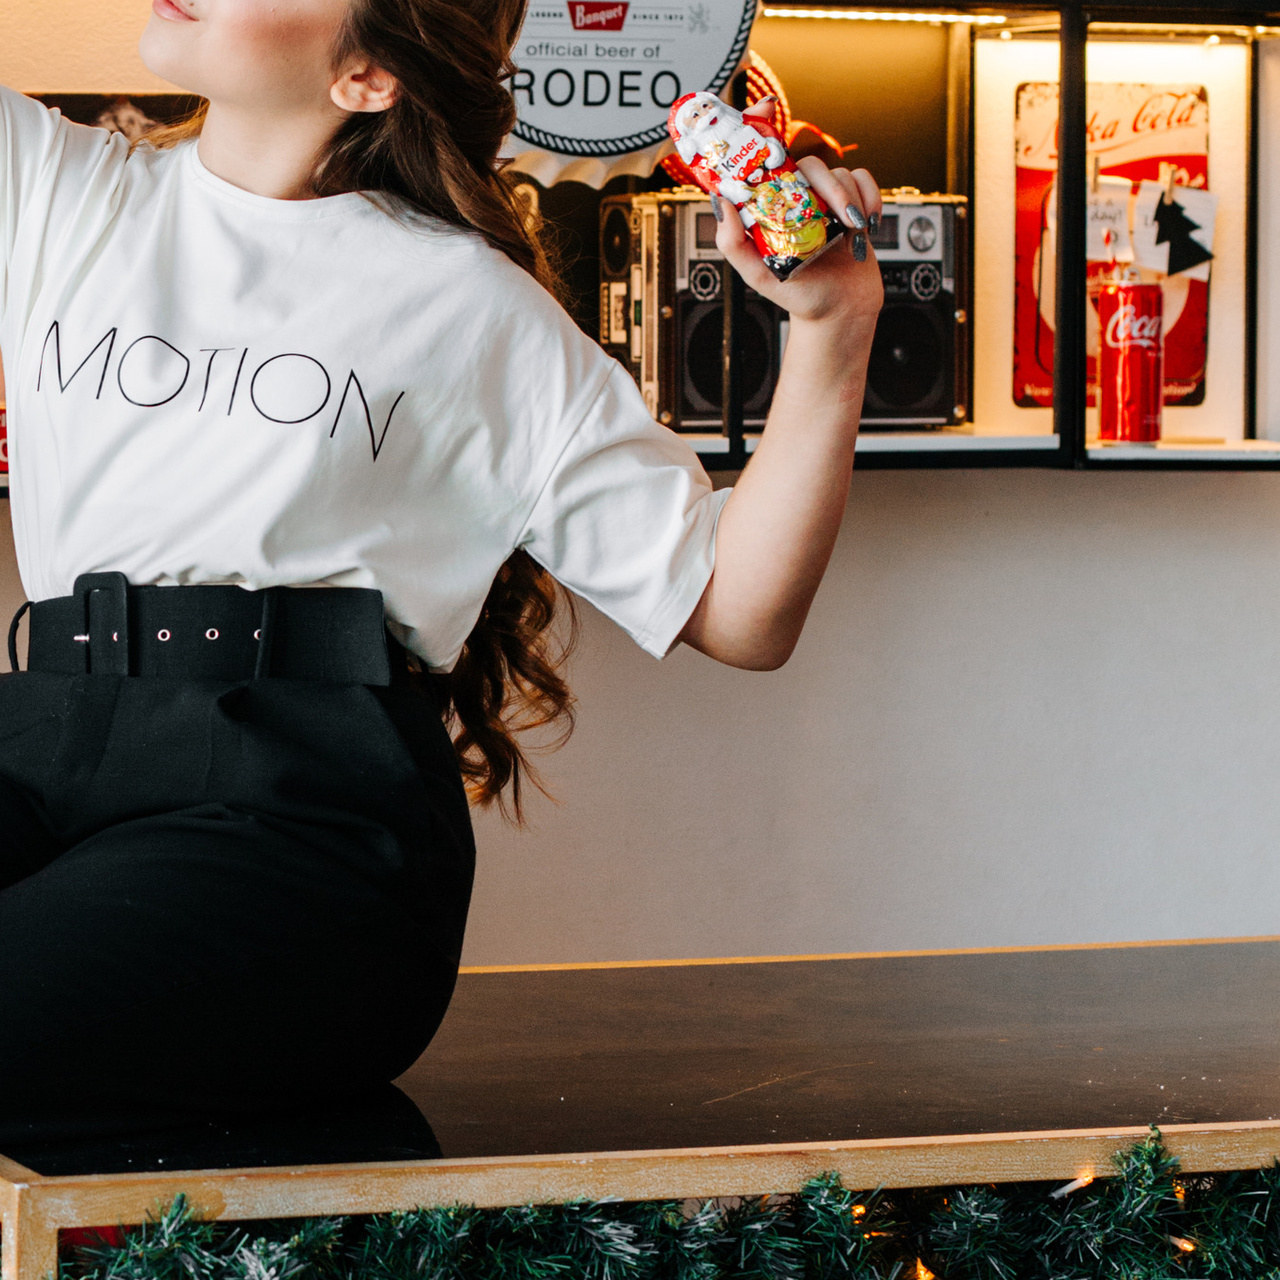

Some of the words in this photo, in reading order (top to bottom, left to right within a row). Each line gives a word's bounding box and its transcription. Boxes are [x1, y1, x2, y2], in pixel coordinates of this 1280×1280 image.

[526, 42, 588, 57] official
[595, 43, 637, 58] beer
[643, 44, 661, 58] of
[511, 67, 682, 109] RODEO
[37, 320, 405, 462] MOTION
